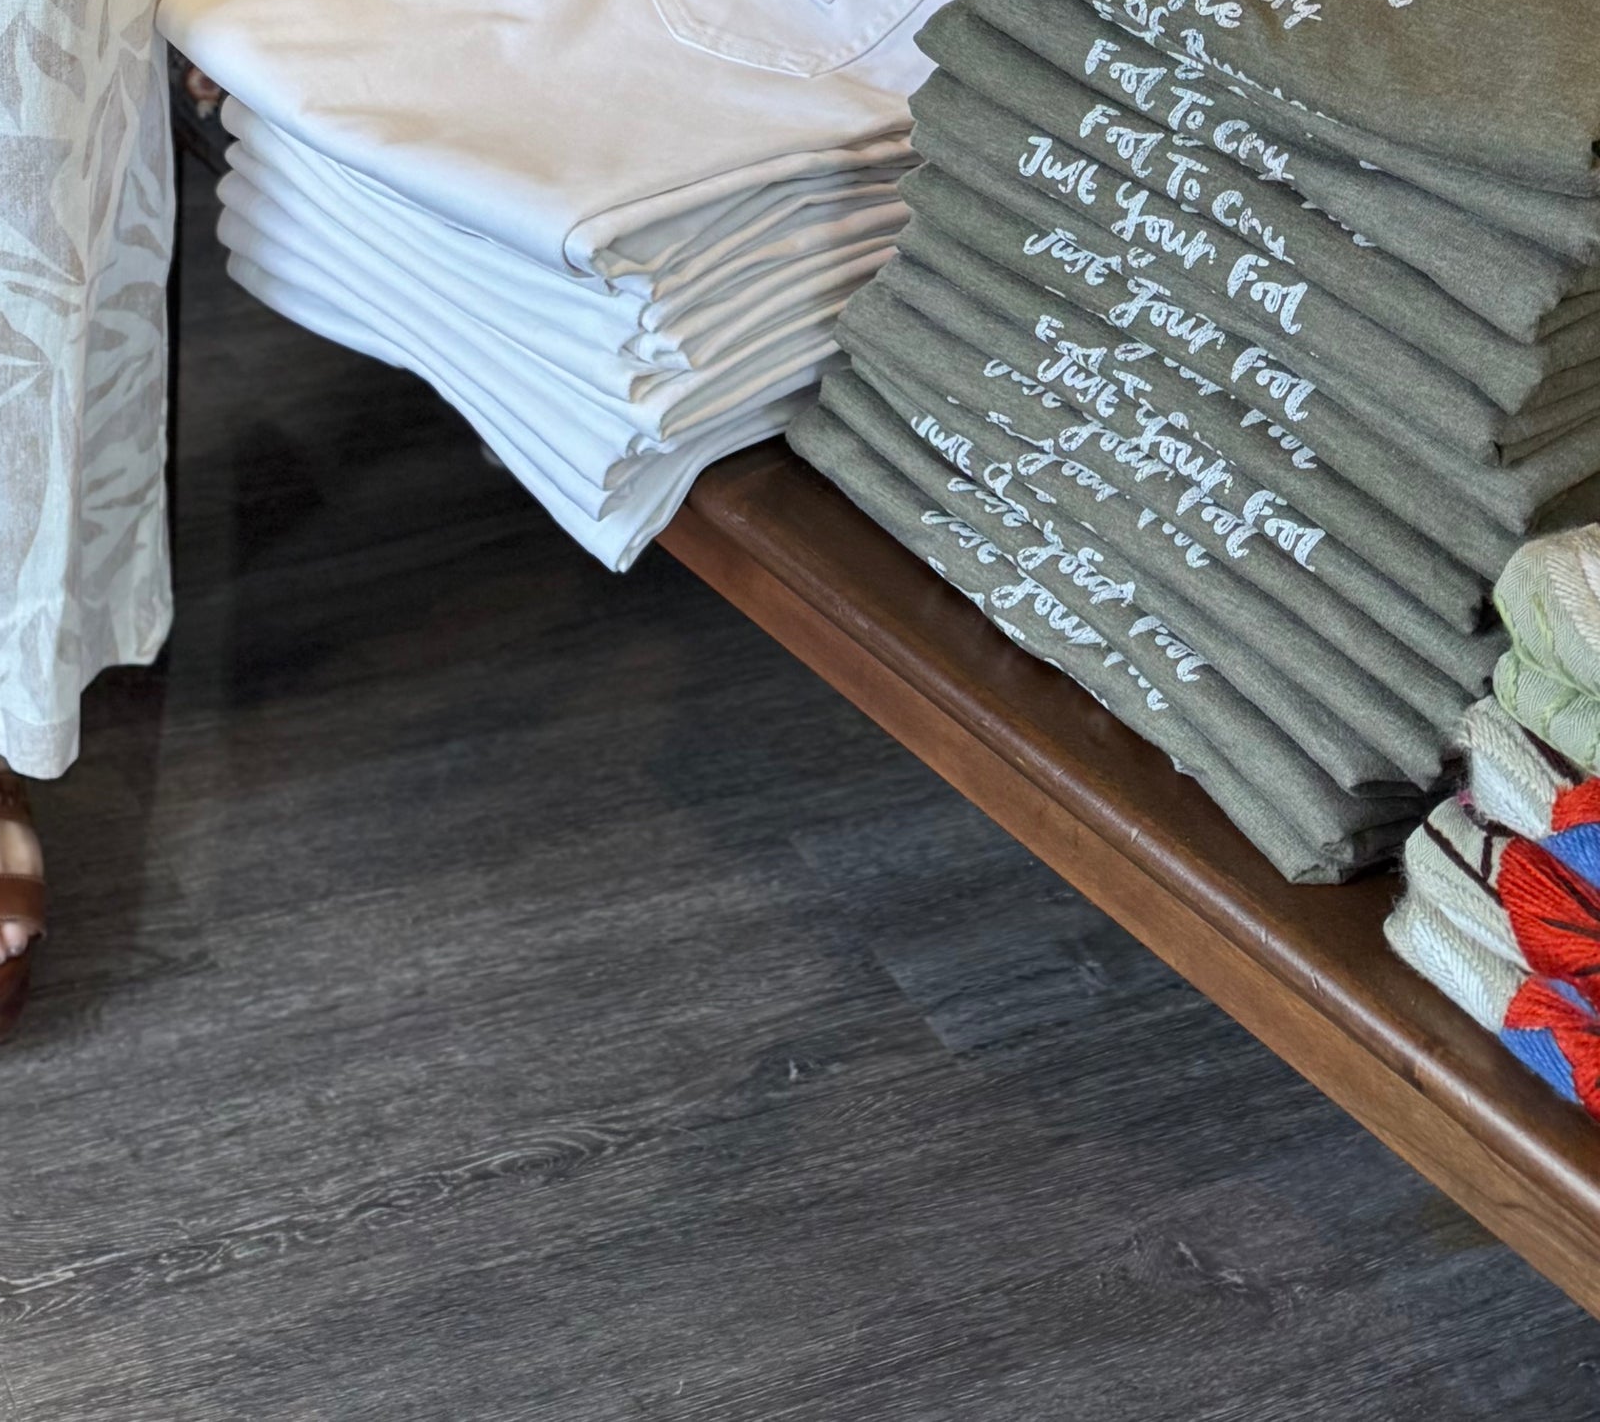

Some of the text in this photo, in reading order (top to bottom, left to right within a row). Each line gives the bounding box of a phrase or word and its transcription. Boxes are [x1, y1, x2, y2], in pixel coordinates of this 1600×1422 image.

[1079, 104, 1295, 265] Fool To Cry
[1084, 39, 1167, 111] Fool
[1168, 86, 1215, 130] To
[1212, 119, 1295, 181] Cry
[1018, 135, 1308, 335] Just Your Fool
[1022, 227, 1110, 286] Just
[1108, 276, 1227, 354] Your
[1231, 346, 1317, 422] Fool
[1036, 356, 1119, 418] Just
[1135, 398, 1234, 494] Your
[1243, 489, 1326, 572] Fool
